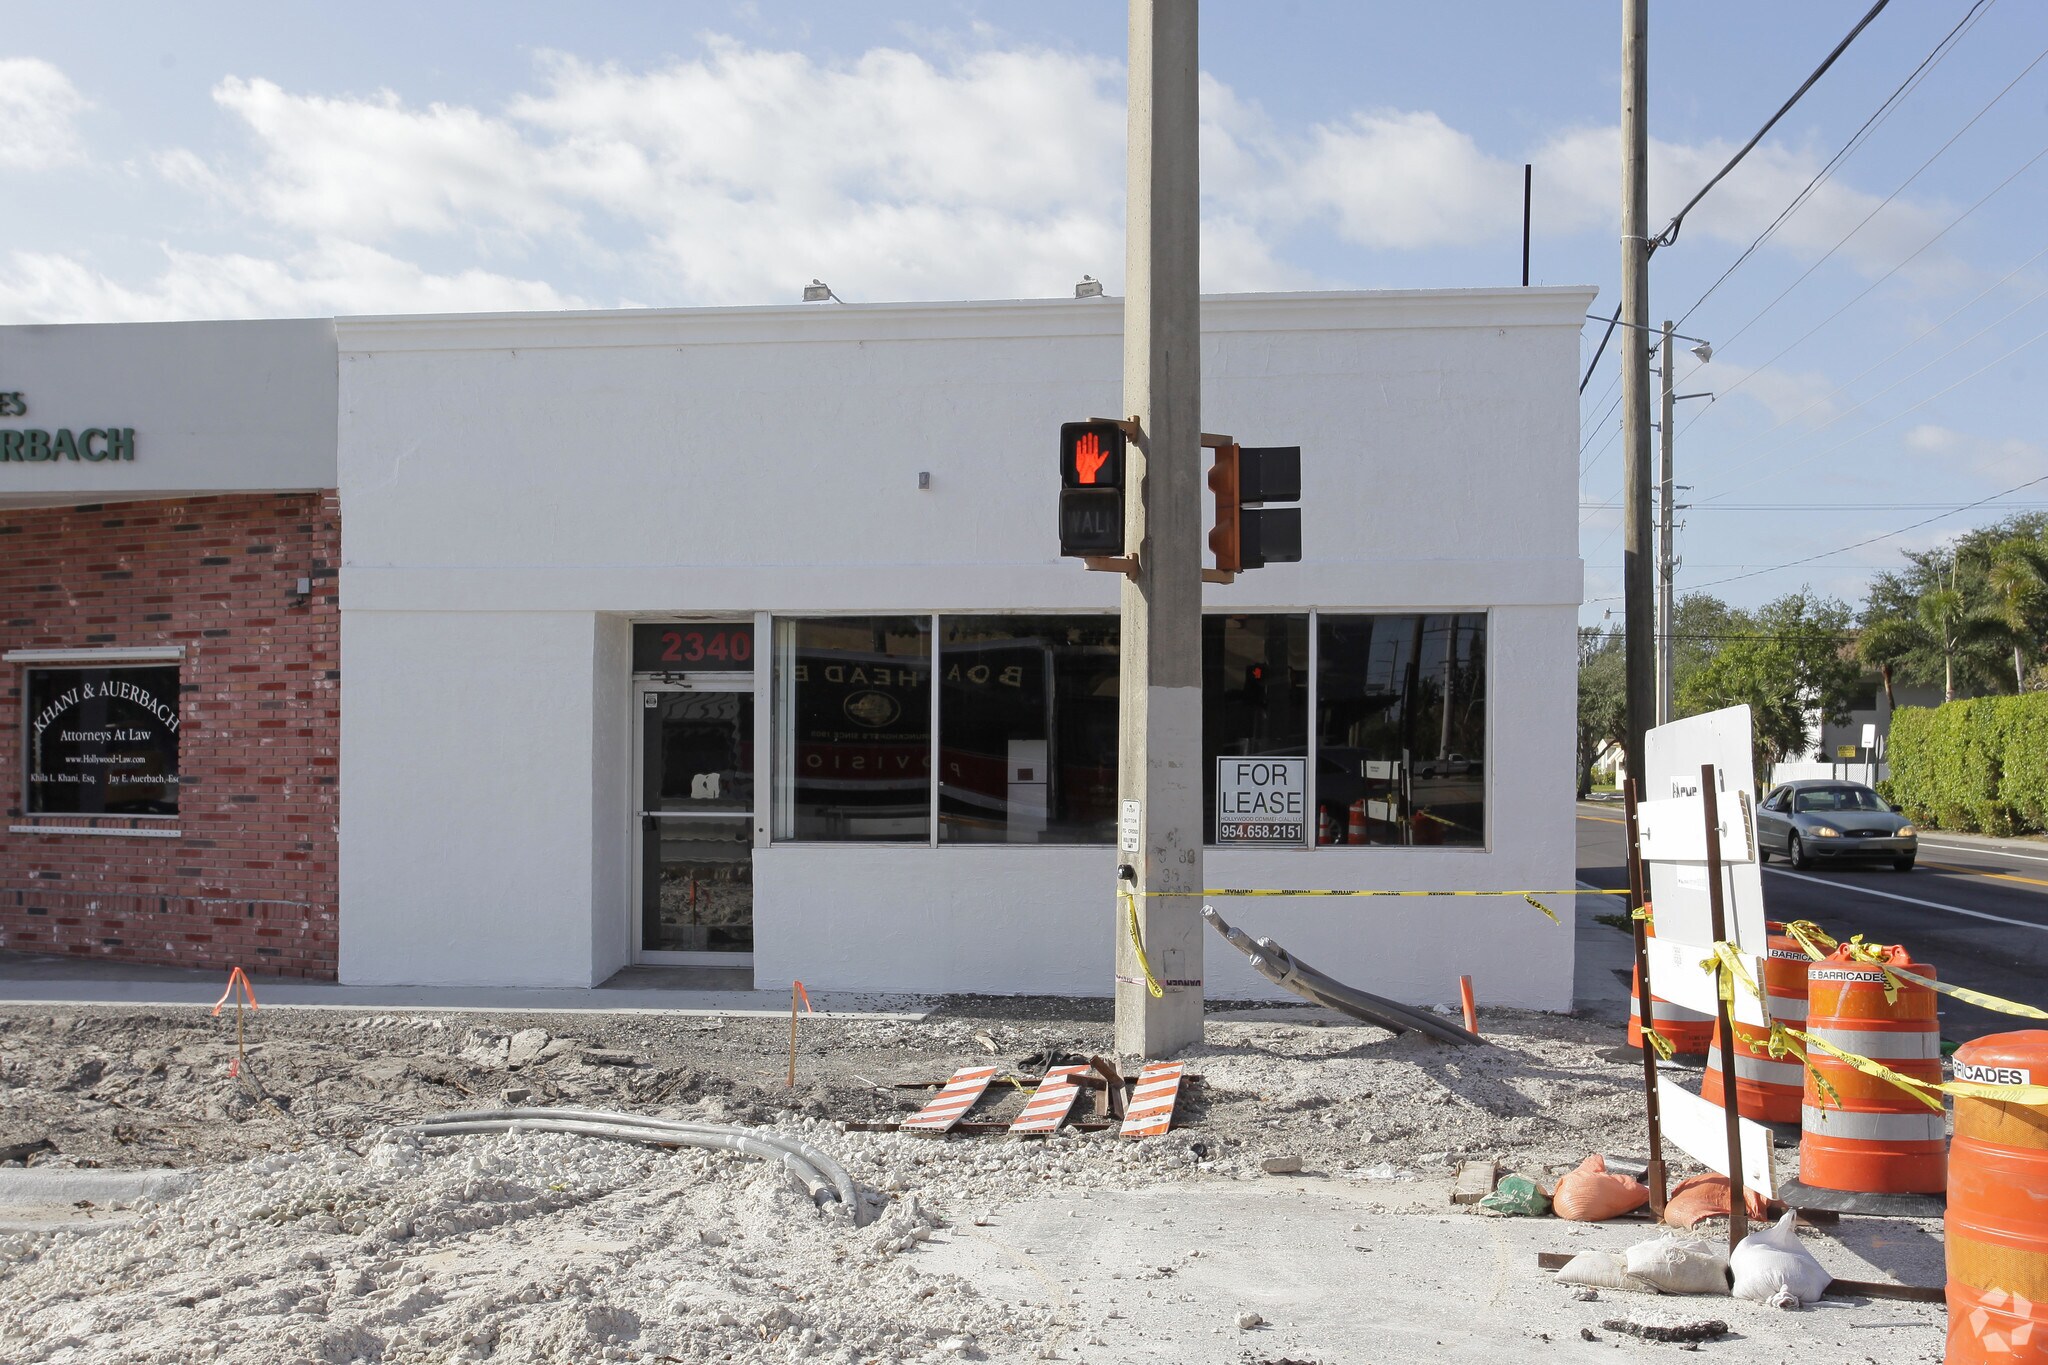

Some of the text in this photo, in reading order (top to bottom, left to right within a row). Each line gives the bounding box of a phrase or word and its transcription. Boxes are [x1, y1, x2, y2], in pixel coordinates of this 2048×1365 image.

[0, 428, 135, 462] RBACH
[661, 632, 751, 661] 2340
[33, 680, 180, 734] KHANI & AUERBACH
[60, 728, 151, 744] Attorneys At Law
[65, 754, 146, 764] www.Hollywood-Law.com
[30, 773, 48, 783] Khila
[82, 774, 97, 785] Esq.
[108, 774, 119, 785] Jay
[1237, 763, 1287, 786] FOR
[1222, 791, 1302, 814] LEASE
[1221, 824, 1302, 839] 954.658.2151
[1817, 970, 1889, 983] BARRICADES
